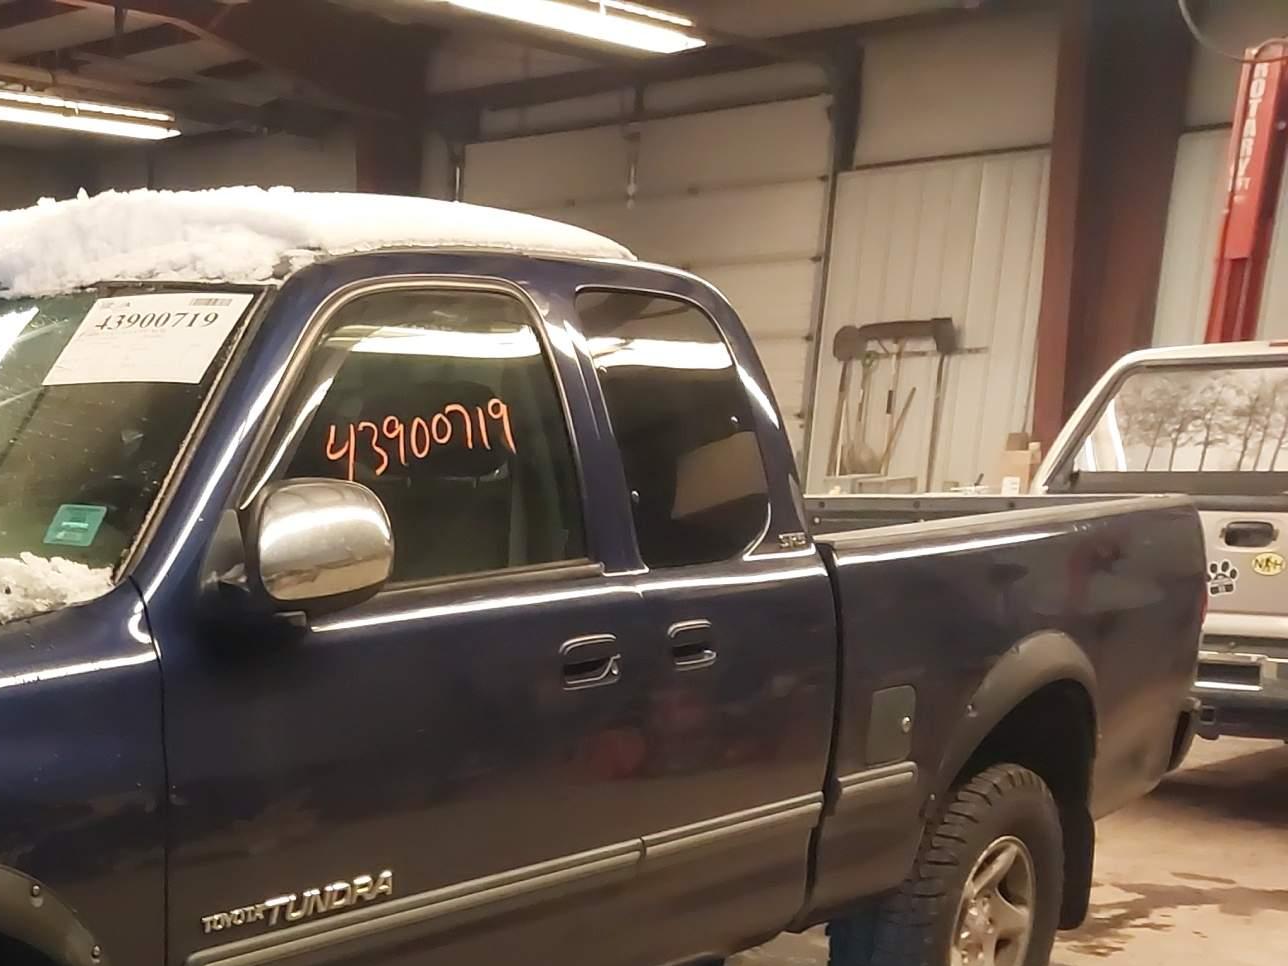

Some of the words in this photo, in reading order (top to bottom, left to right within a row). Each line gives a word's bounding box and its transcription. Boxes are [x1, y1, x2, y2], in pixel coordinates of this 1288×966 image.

[96, 311, 219, 330] 43900719
[326, 399, 516, 480] 43900719
[201, 903, 265, 933] TOYOTA
[265, 870, 393, 926] TUNDRA
